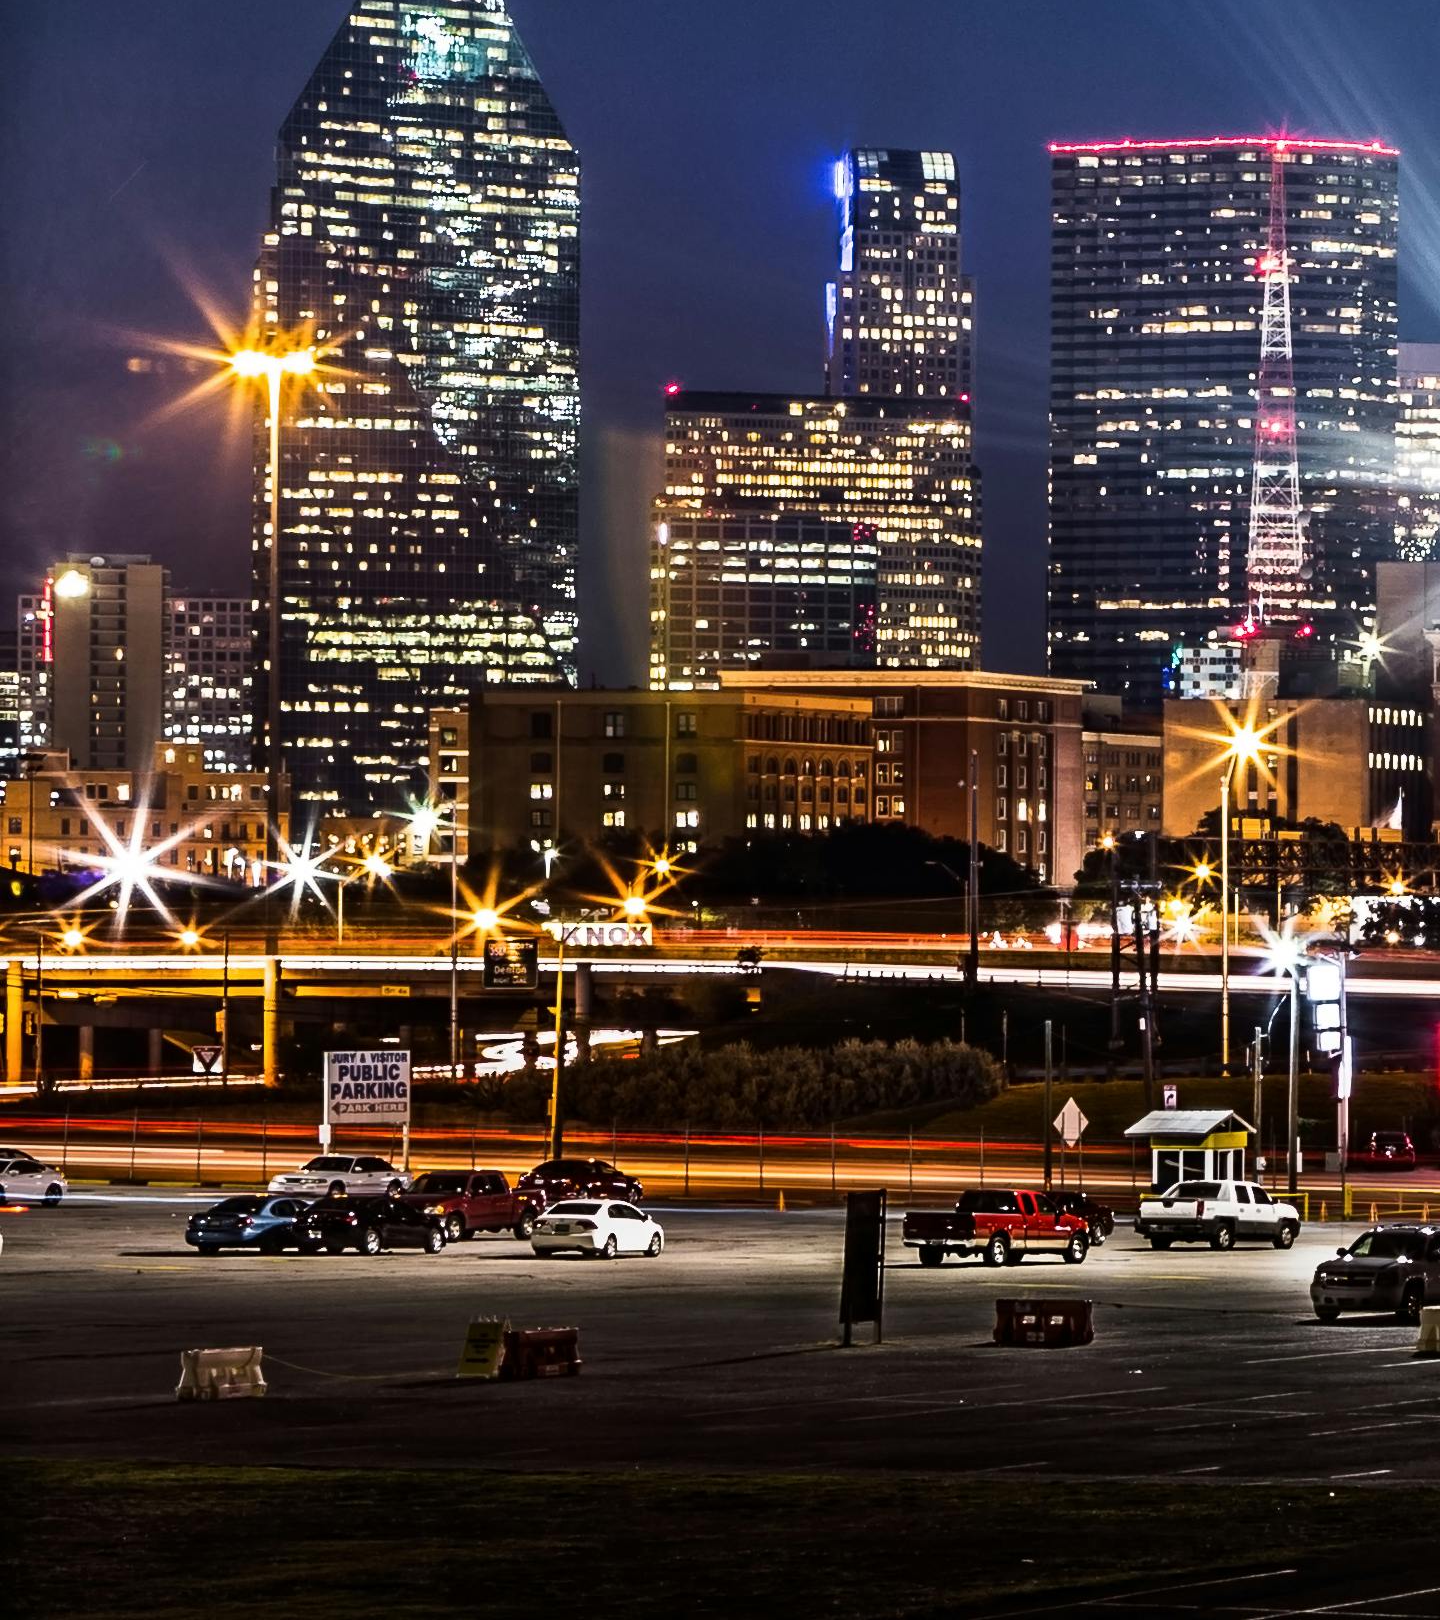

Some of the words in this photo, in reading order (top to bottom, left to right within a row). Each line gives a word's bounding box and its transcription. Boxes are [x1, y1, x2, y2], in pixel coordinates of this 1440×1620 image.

[563, 926, 649, 946] KNOX
[331, 1053, 357, 1063] JURY
[360, 1053, 366, 1063] &
[370, 1052, 407, 1062] VISITOR
[338, 1064, 400, 1081] PUBLIC
[331, 1082, 407, 1100] PARKING
[340, 1103, 370, 1113] PARK
[375, 1103, 405, 1112] HERE
